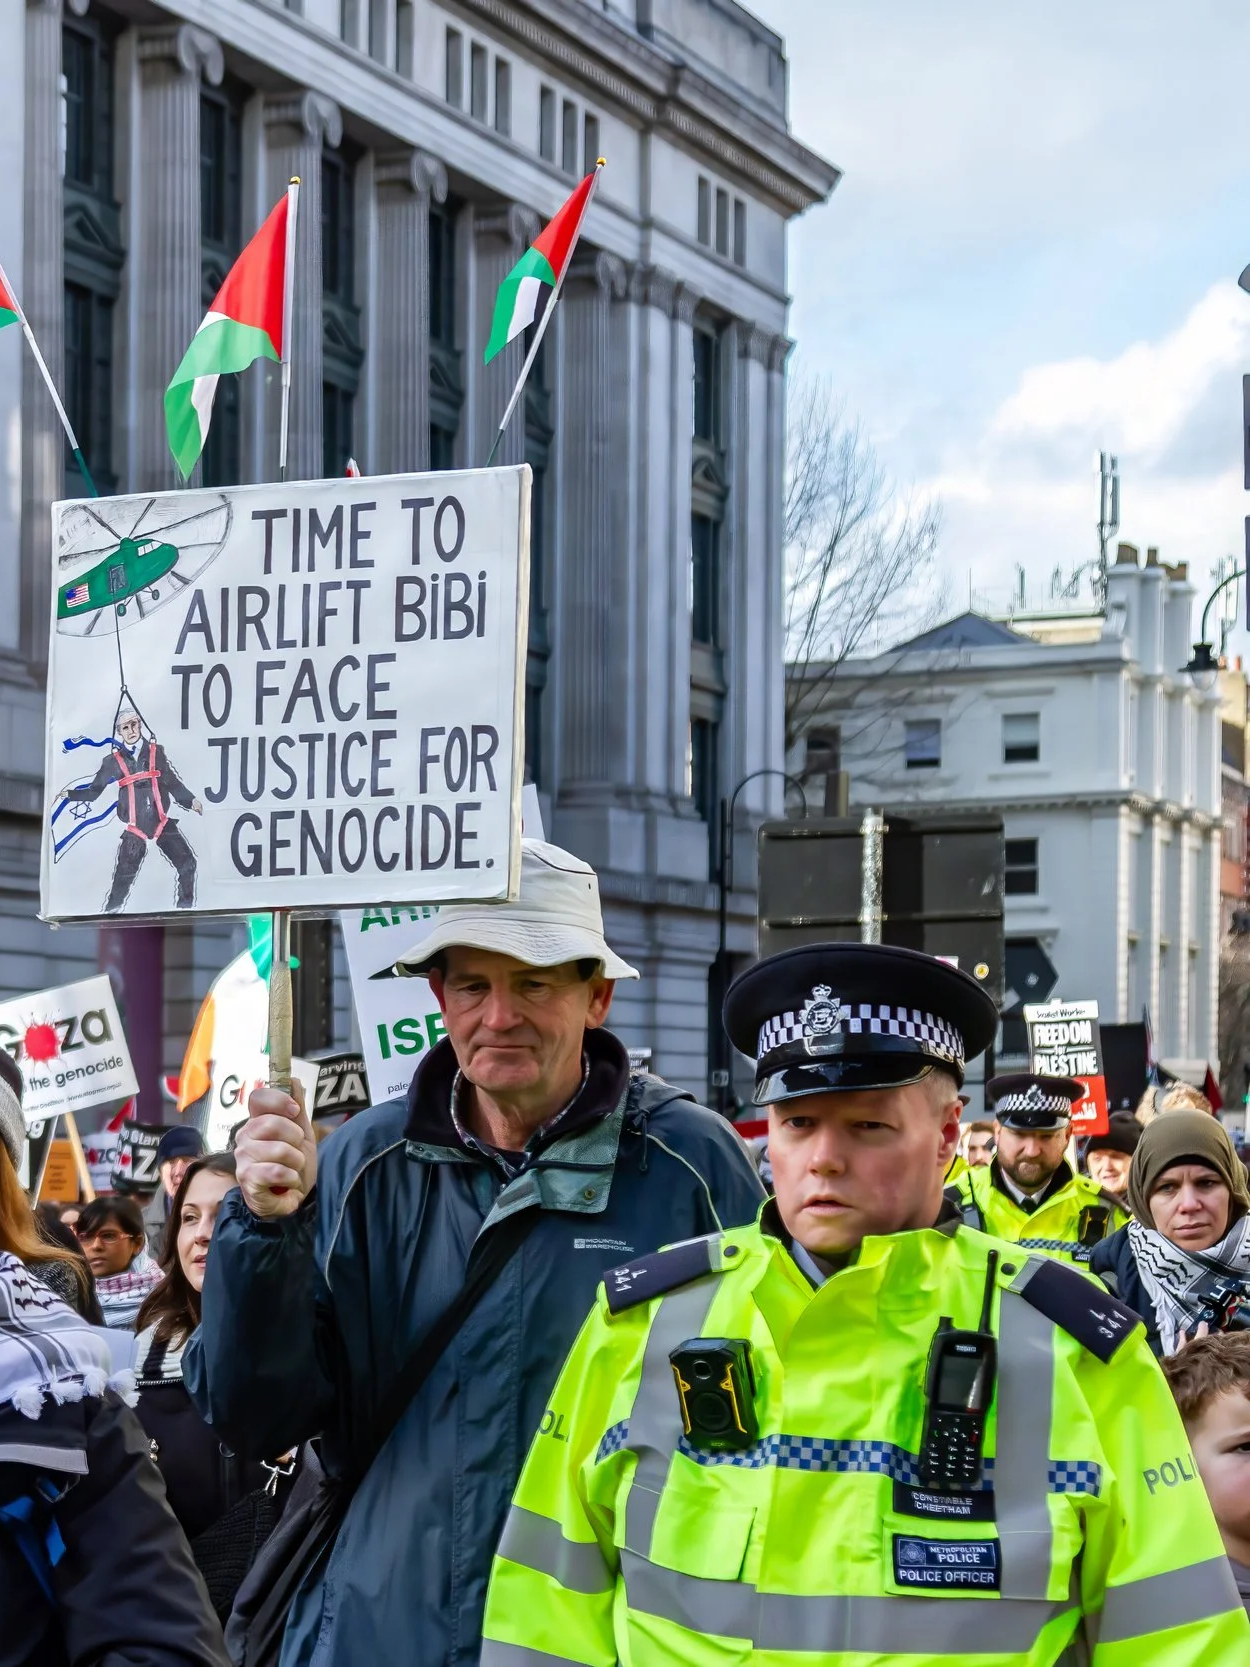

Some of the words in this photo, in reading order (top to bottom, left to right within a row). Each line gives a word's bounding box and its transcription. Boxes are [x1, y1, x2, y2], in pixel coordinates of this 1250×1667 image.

[251, 502, 377, 575] TIME
[401, 495, 466, 566] TO
[175, 579, 371, 655] AIRLIFT
[172, 663, 233, 730] TO
[255, 653, 398, 727] FACE
[204, 729, 398, 805] JUSTICE
[419, 725, 500, 795] FOR
[230, 802, 495, 878] GENOCIDE.
[1034, 1020, 1092, 1047] FREEDOM
[29, 1077, 51, 1091] the
[55, 1055, 124, 1088] genocide
[319, 1060, 366, 1076] arving
[1033, 1050, 1098, 1077] PALESTINE
[316, 1073, 368, 1108] ZA
[586, 1244, 634, 1252] WAREHOUSE
[912, 1492, 973, 1506] CONSTABLE
[915, 1501, 971, 1515] CHEETHAM
[929, 1546, 987, 1554] METROPOLITAN
[938, 1553, 980, 1563] POLICE
[899, 1570, 942, 1582] POLICE
[945, 1571, 995, 1583] OFFICER
